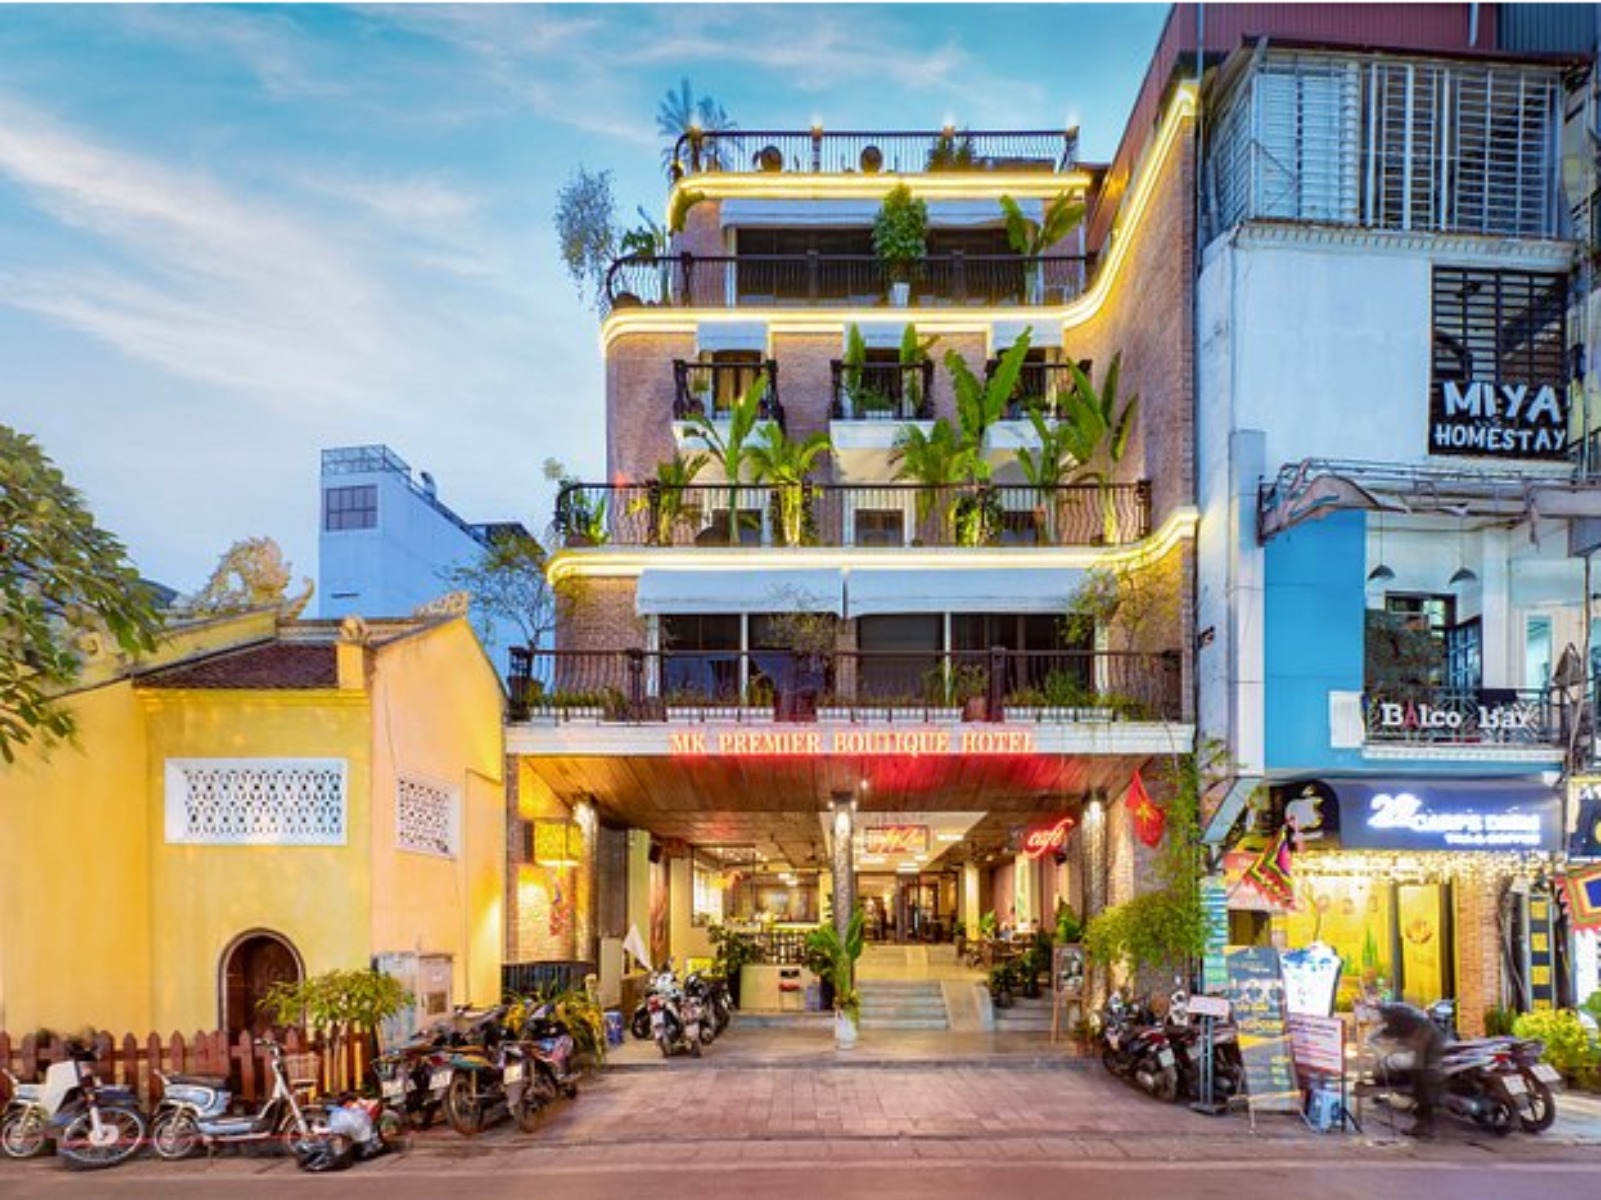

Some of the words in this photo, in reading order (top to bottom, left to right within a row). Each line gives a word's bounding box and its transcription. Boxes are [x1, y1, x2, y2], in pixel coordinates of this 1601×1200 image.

[1443, 381, 1562, 423] MIYA
[1435, 424, 1567, 450] HOMESTAY
[670, 731, 706, 754] MK
[718, 731, 822, 754] PREMIER
[833, 731, 950, 757] BOUTIQUE
[962, 731, 1034, 754] HOTEL
